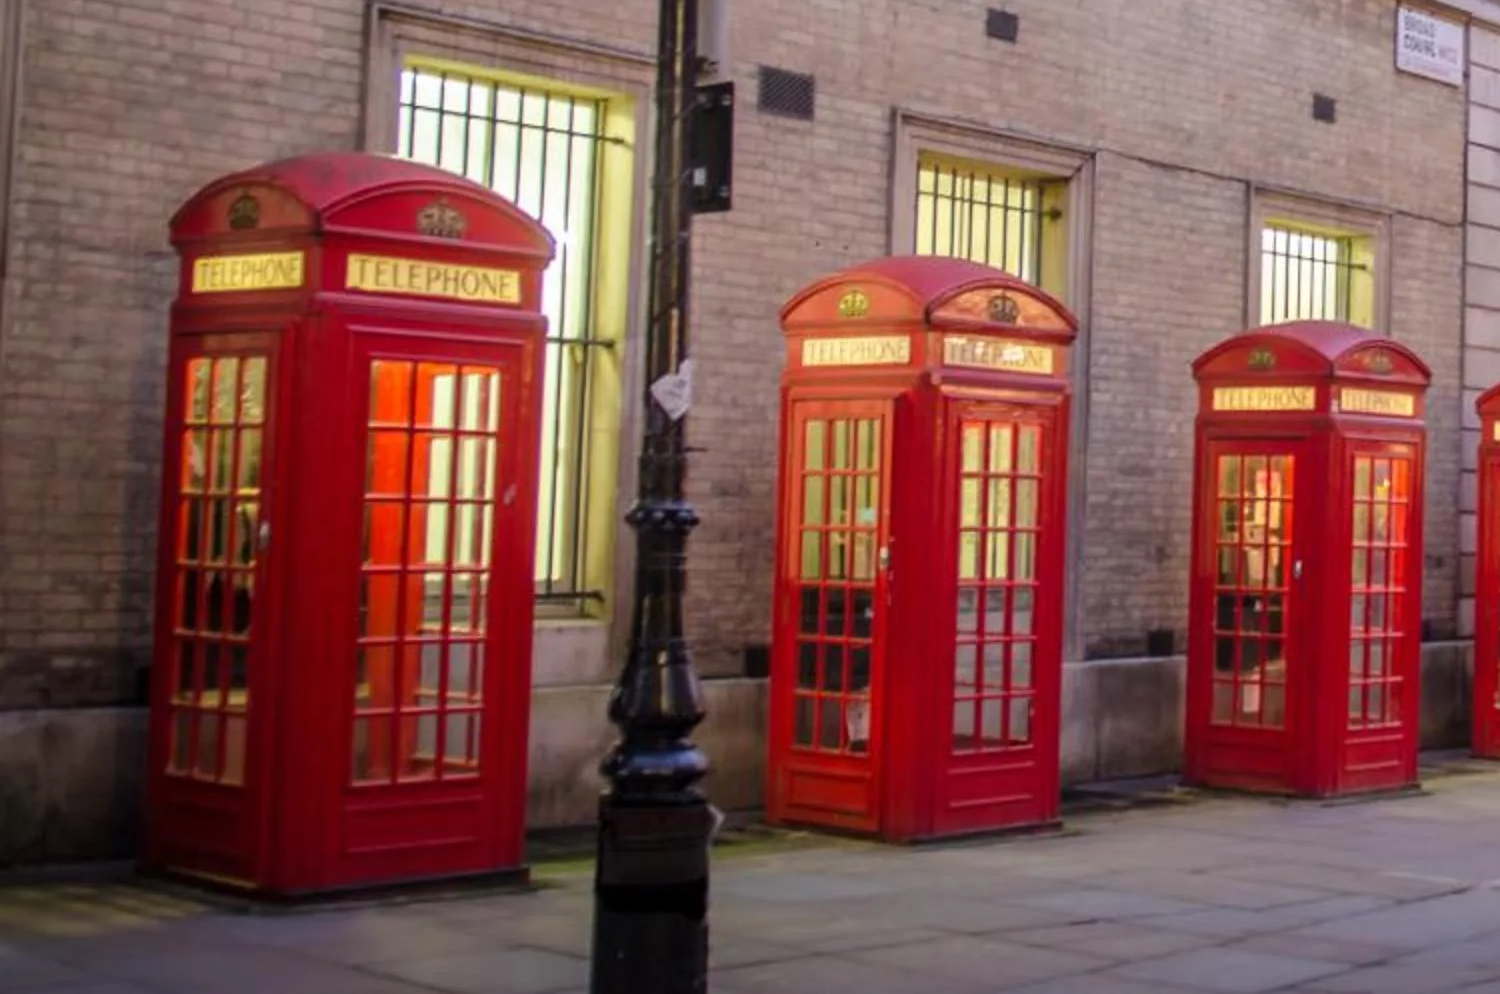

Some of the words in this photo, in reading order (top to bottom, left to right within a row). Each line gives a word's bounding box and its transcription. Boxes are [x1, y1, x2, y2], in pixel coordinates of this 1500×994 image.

[199, 256, 301, 288] TELEPHONE
[355, 257, 513, 299] TELEPHONE
[808, 337, 908, 362] TELEPHONE
[1219, 387, 1309, 408] TELEPHONE
